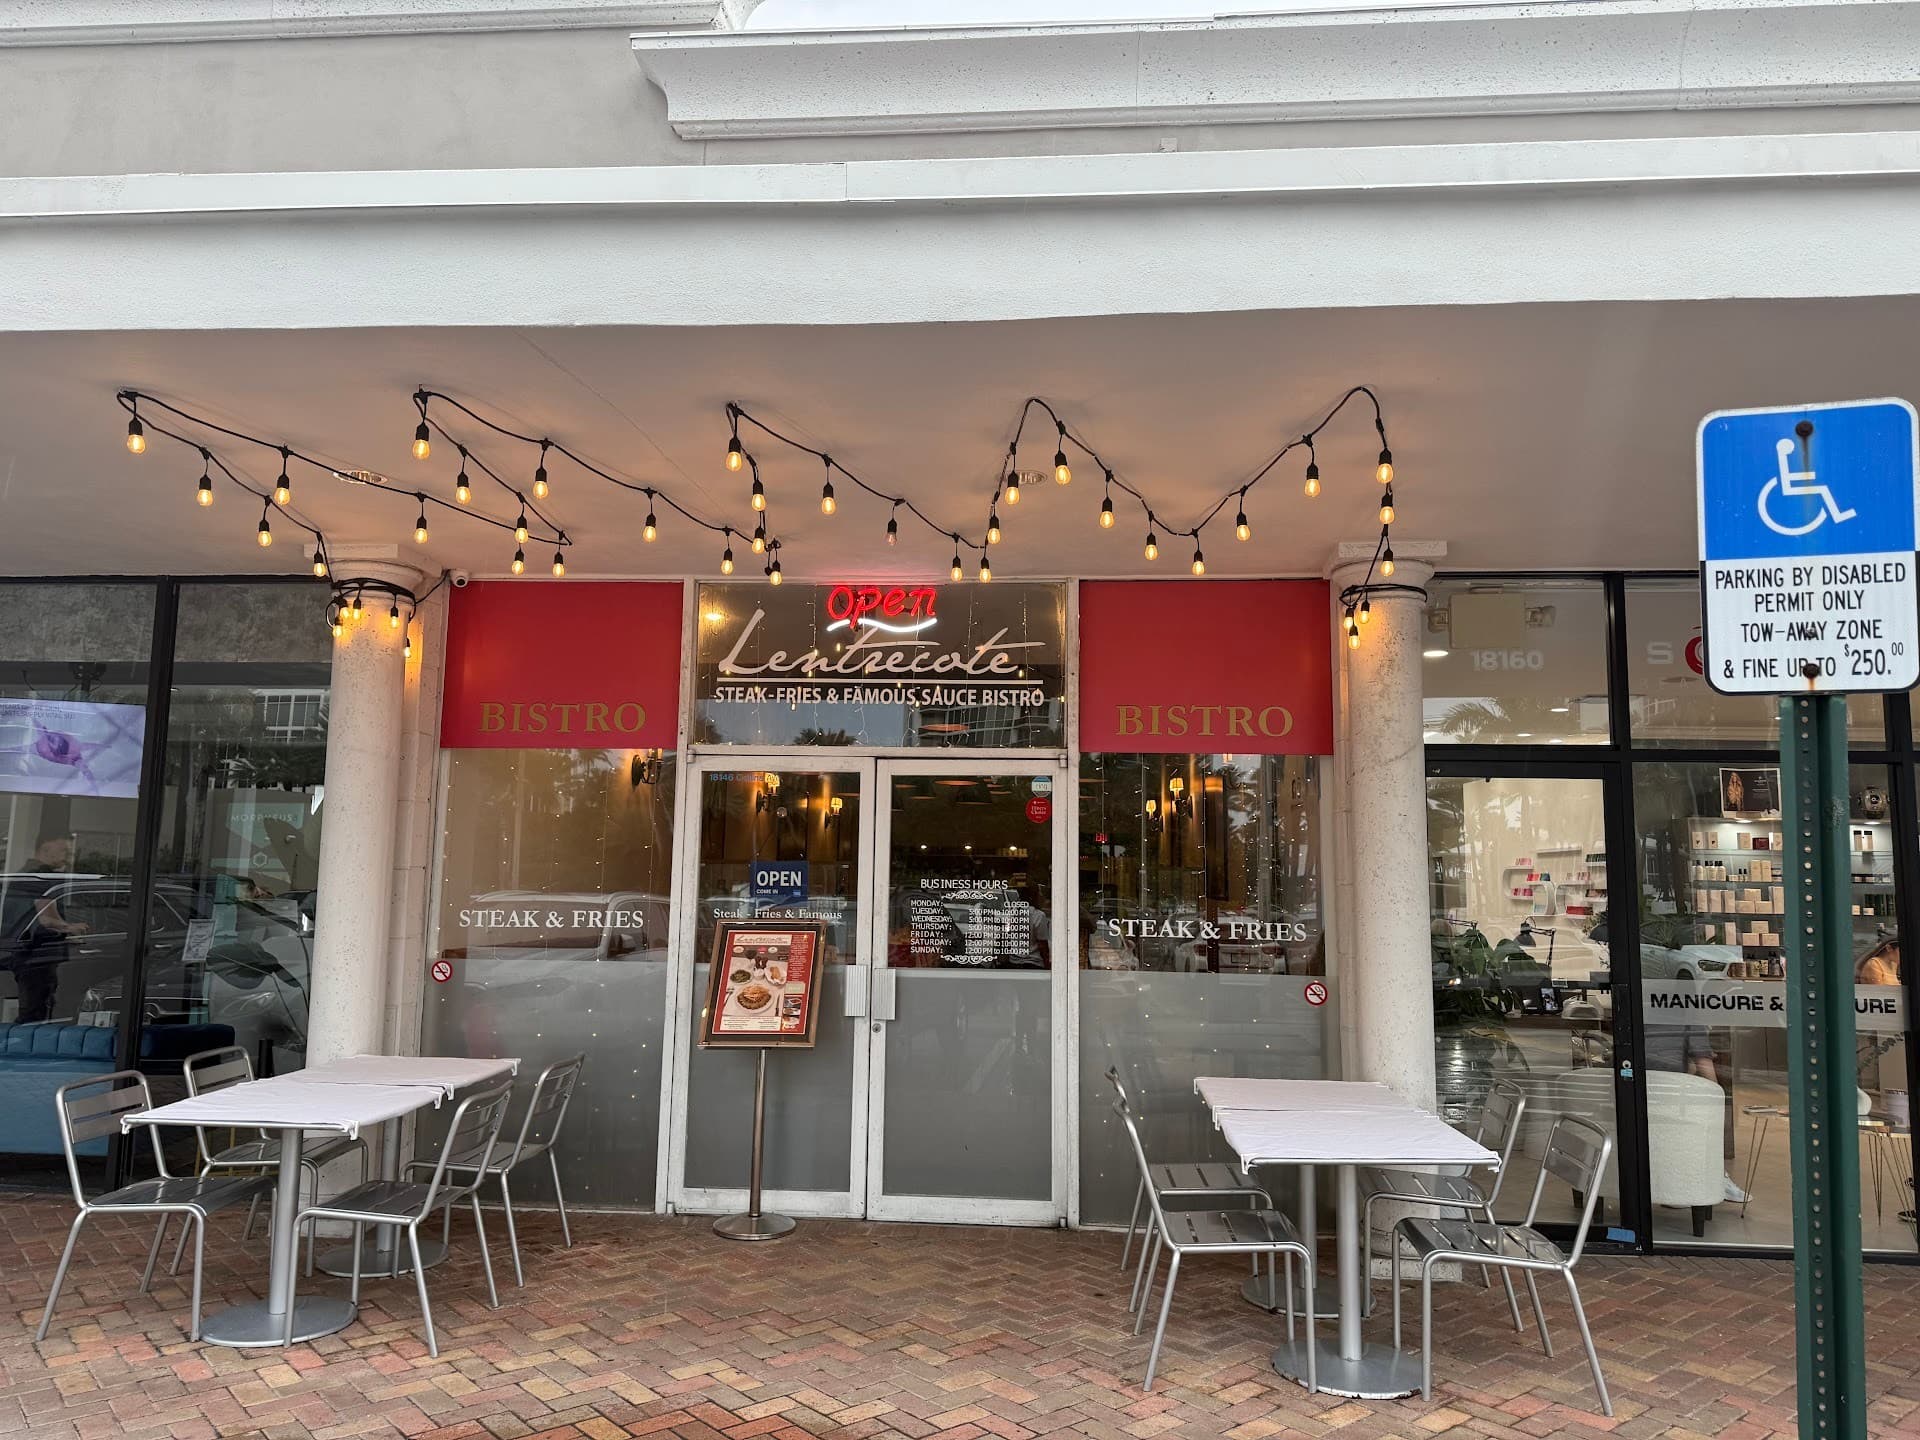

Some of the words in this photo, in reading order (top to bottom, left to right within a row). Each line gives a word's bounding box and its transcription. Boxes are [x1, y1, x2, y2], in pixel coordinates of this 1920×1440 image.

[1715, 567, 1784, 589] PARKING
[1793, 566, 1814, 586] BY
[1822, 562, 1906, 585] DISABLED
[1754, 591, 1814, 613] PERMIT
[1823, 590, 1865, 610] ONLY
[1740, 621, 1828, 643] TOW-AWAY
[1836, 619, 1883, 640] ZONE
[718, 608, 1046, 675] Lentrecote
[1471, 650, 1545, 671] 18160
[1723, 659, 1734, 679] &
[1743, 658, 1778, 679] FINE
[715, 686, 822, 705] STEAK-FRIES
[826, 687, 839, 703] &
[843, 687, 916, 706] FAMOUS
[917, 688, 979, 706] SAUCE
[982, 689, 1044, 707] BISTRO
[478, 702, 647, 733] BISTRO
[1115, 705, 1294, 737] BISTRO
[756, 870, 802, 887] OPEN
[920, 879, 971, 889] BUSINESS
[972, 879, 1009, 889] HOURS
[910, 899, 943, 907] MONDAY:
[911, 907, 944, 915] TUESDAY:
[983, 908, 993, 916] PM
[1019, 908, 1030, 916] PM
[459, 909, 540, 928] STEAK
[545, 910, 565, 929] &
[571, 910, 644, 929] FRIES
[713, 908, 745, 919] Steak
[754, 908, 781, 919] Fries
[784, 909, 795, 919] &
[799, 909, 842, 919] Famous
[911, 915, 953, 923] WEDNESDAY:
[983, 916, 993, 924] PM
[1019, 916, 1030, 924] PM
[983, 924, 993, 932] PM
[1019, 924, 1030, 932] PM
[983, 932, 993, 940] PM
[1019, 932, 1030, 940] PM
[1108, 918, 1196, 940] STEAK
[1200, 921, 1221, 940] &
[1229, 922, 1308, 942] FRIES
[910, 938, 952, 946] SATURDAY:
[910, 946, 943, 954] SUNDAY:
[983, 947, 993, 955] PM
[1019, 947, 1030, 955] PM
[1650, 993, 1764, 1011] MANICURE
[1769, 996, 1784, 1011] &
